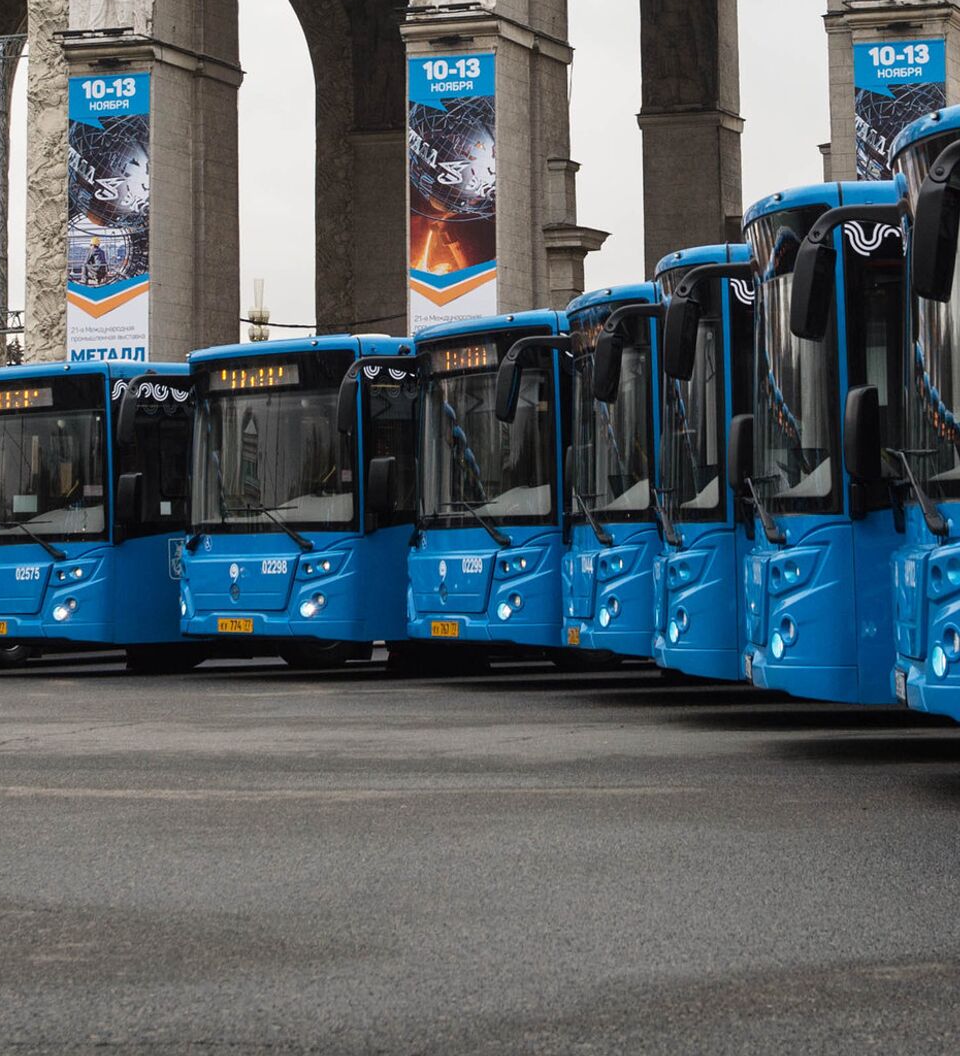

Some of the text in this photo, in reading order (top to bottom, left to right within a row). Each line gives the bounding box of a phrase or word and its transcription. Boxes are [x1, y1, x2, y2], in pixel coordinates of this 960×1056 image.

[869, 44, 929, 65] 10-13
[423, 58, 480, 80] 10-13
[877, 67, 922, 78] НОЯБРЯ
[82, 78, 136, 98] 10-13
[430, 81, 473, 92] НОЯБРЯ
[89, 100, 129, 111] НОЯБРЯ
[71, 347, 145, 362] МЕТАЛЛ
[15, 567, 40, 580] 02575
[261, 560, 287, 574] 02298
